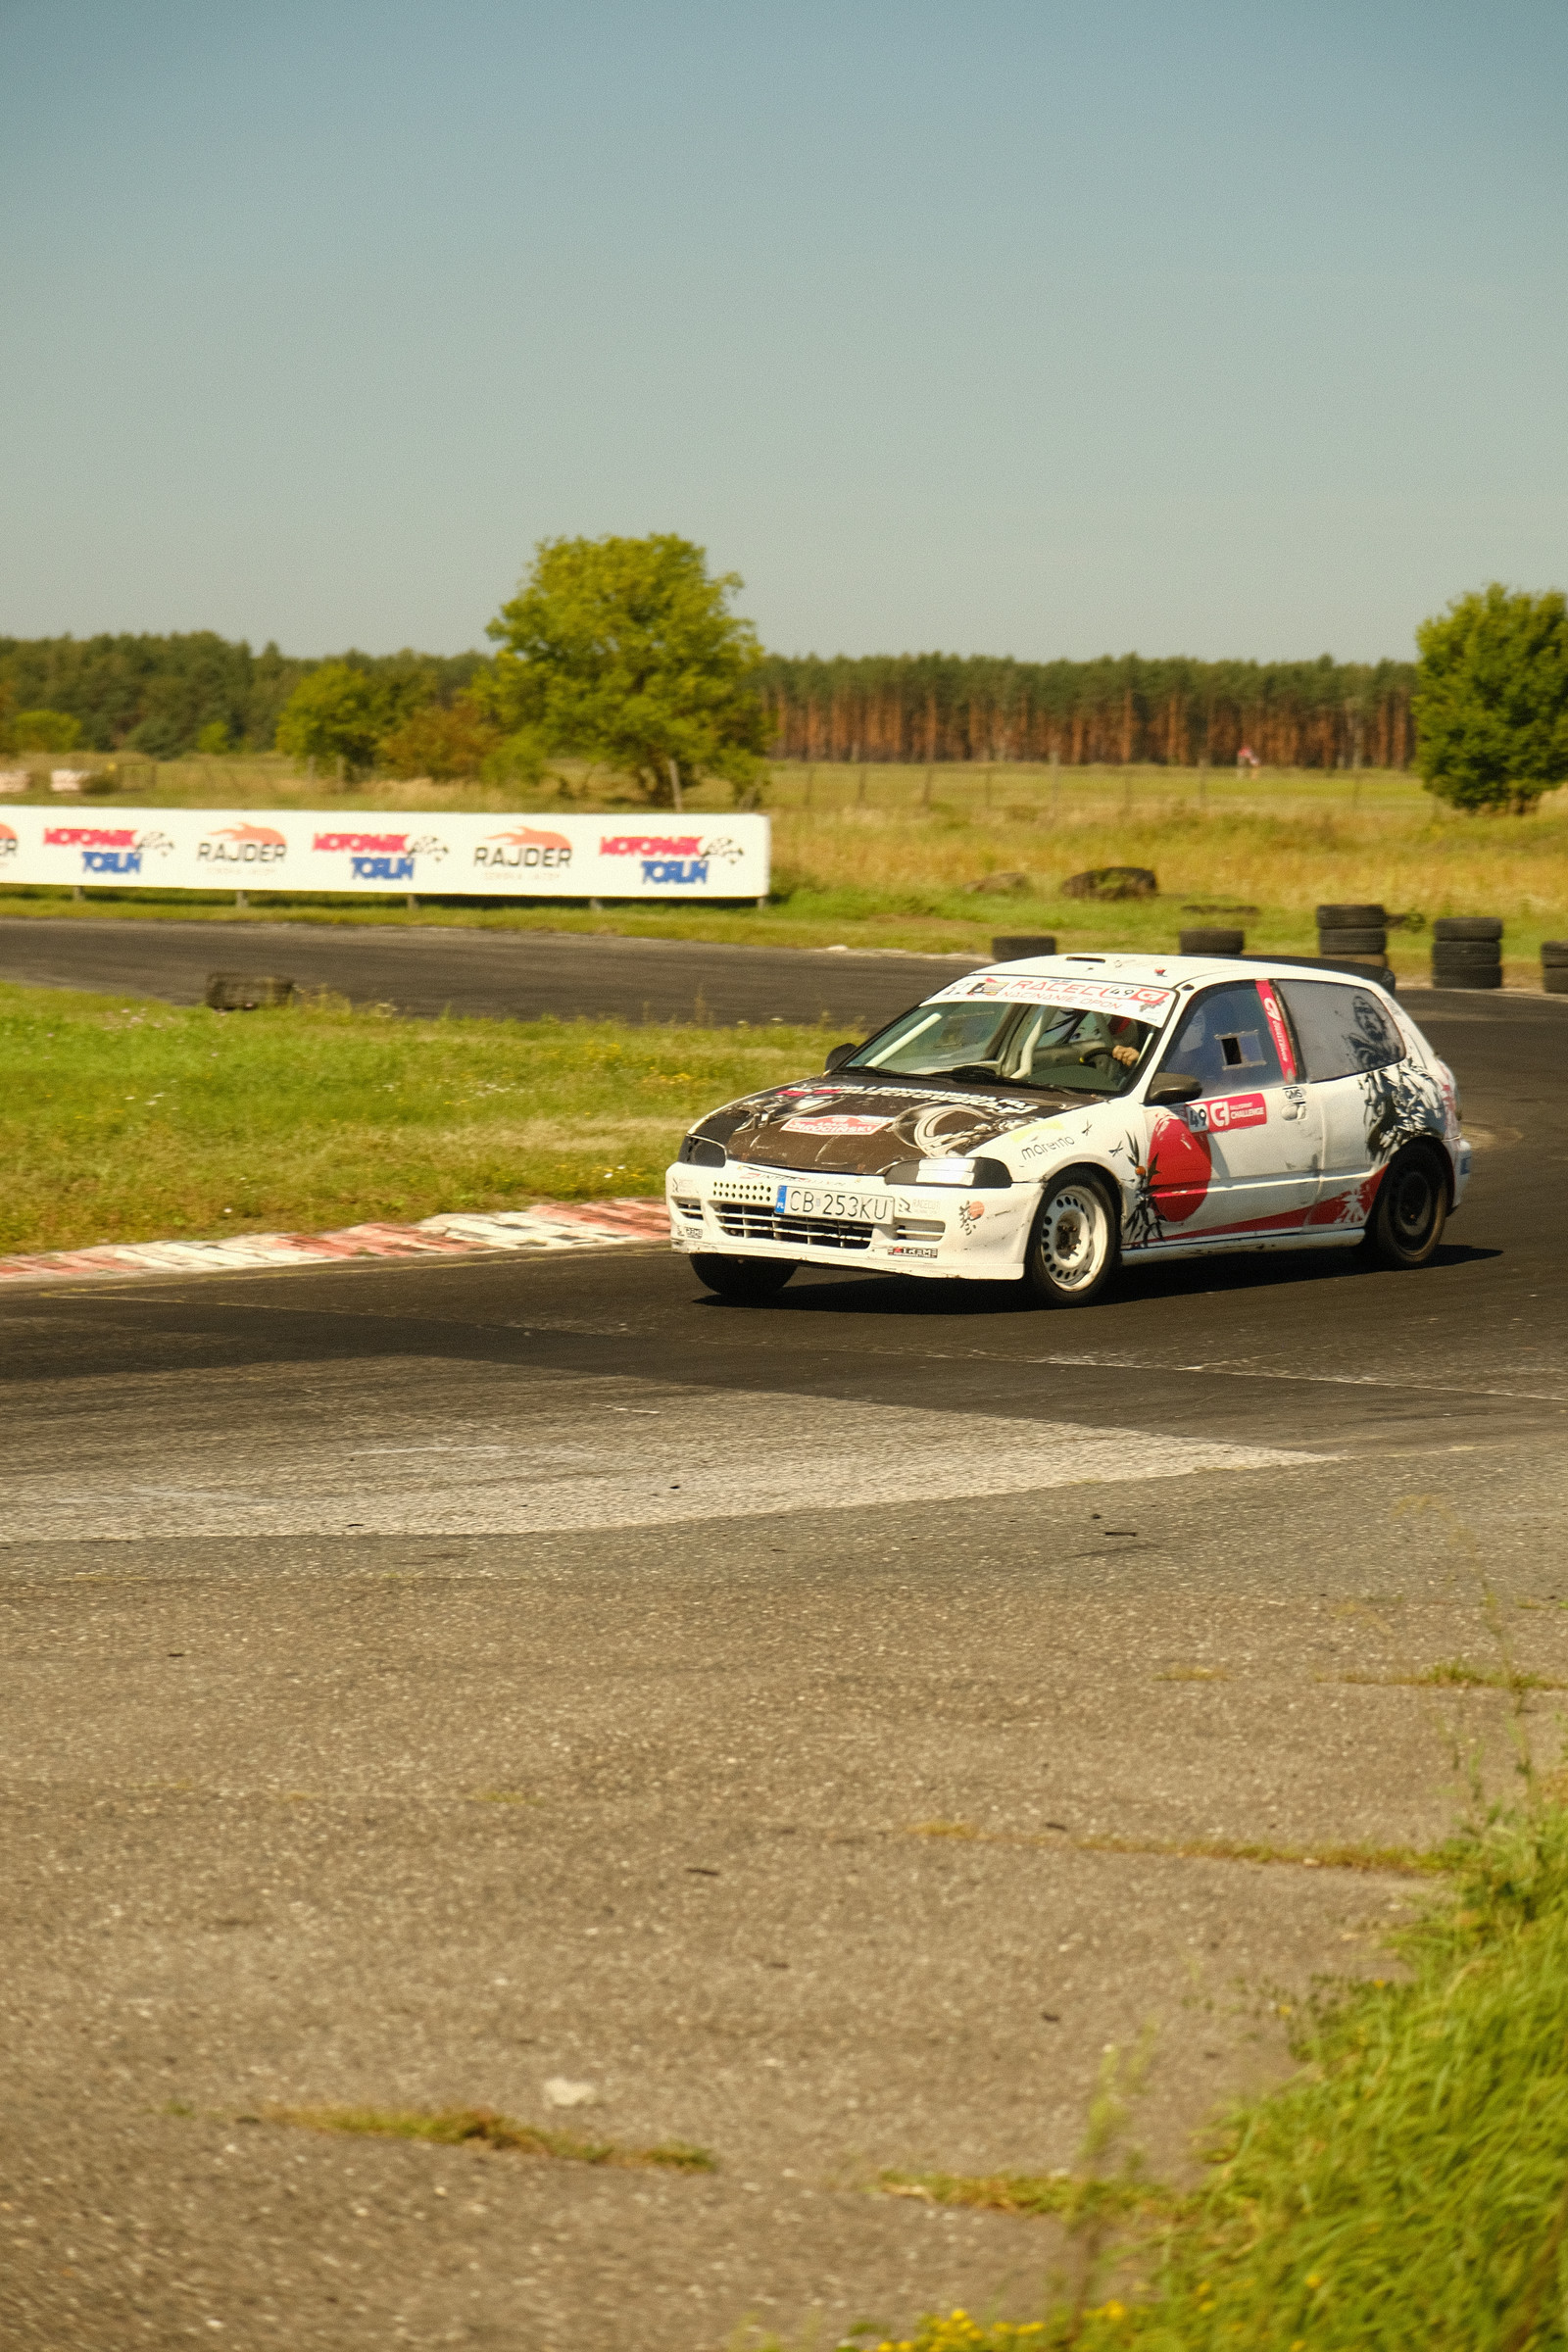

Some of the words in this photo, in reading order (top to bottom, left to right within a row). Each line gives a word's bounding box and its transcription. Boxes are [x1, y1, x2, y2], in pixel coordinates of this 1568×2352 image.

[196, 843, 287, 863] RAJDER
[473, 847, 572, 868] RAJDER
[1003, 991, 1075, 1004] NACINANIE
[1081, 998, 1123, 1010] OPON
[1108, 987, 1135, 998] 49
[1188, 1108, 1207, 1129] 49
[1230, 1107, 1265, 1120] CHALLENGE
[790, 1190, 814, 1213] CB
[822, 1194, 888, 1220] 253KU
